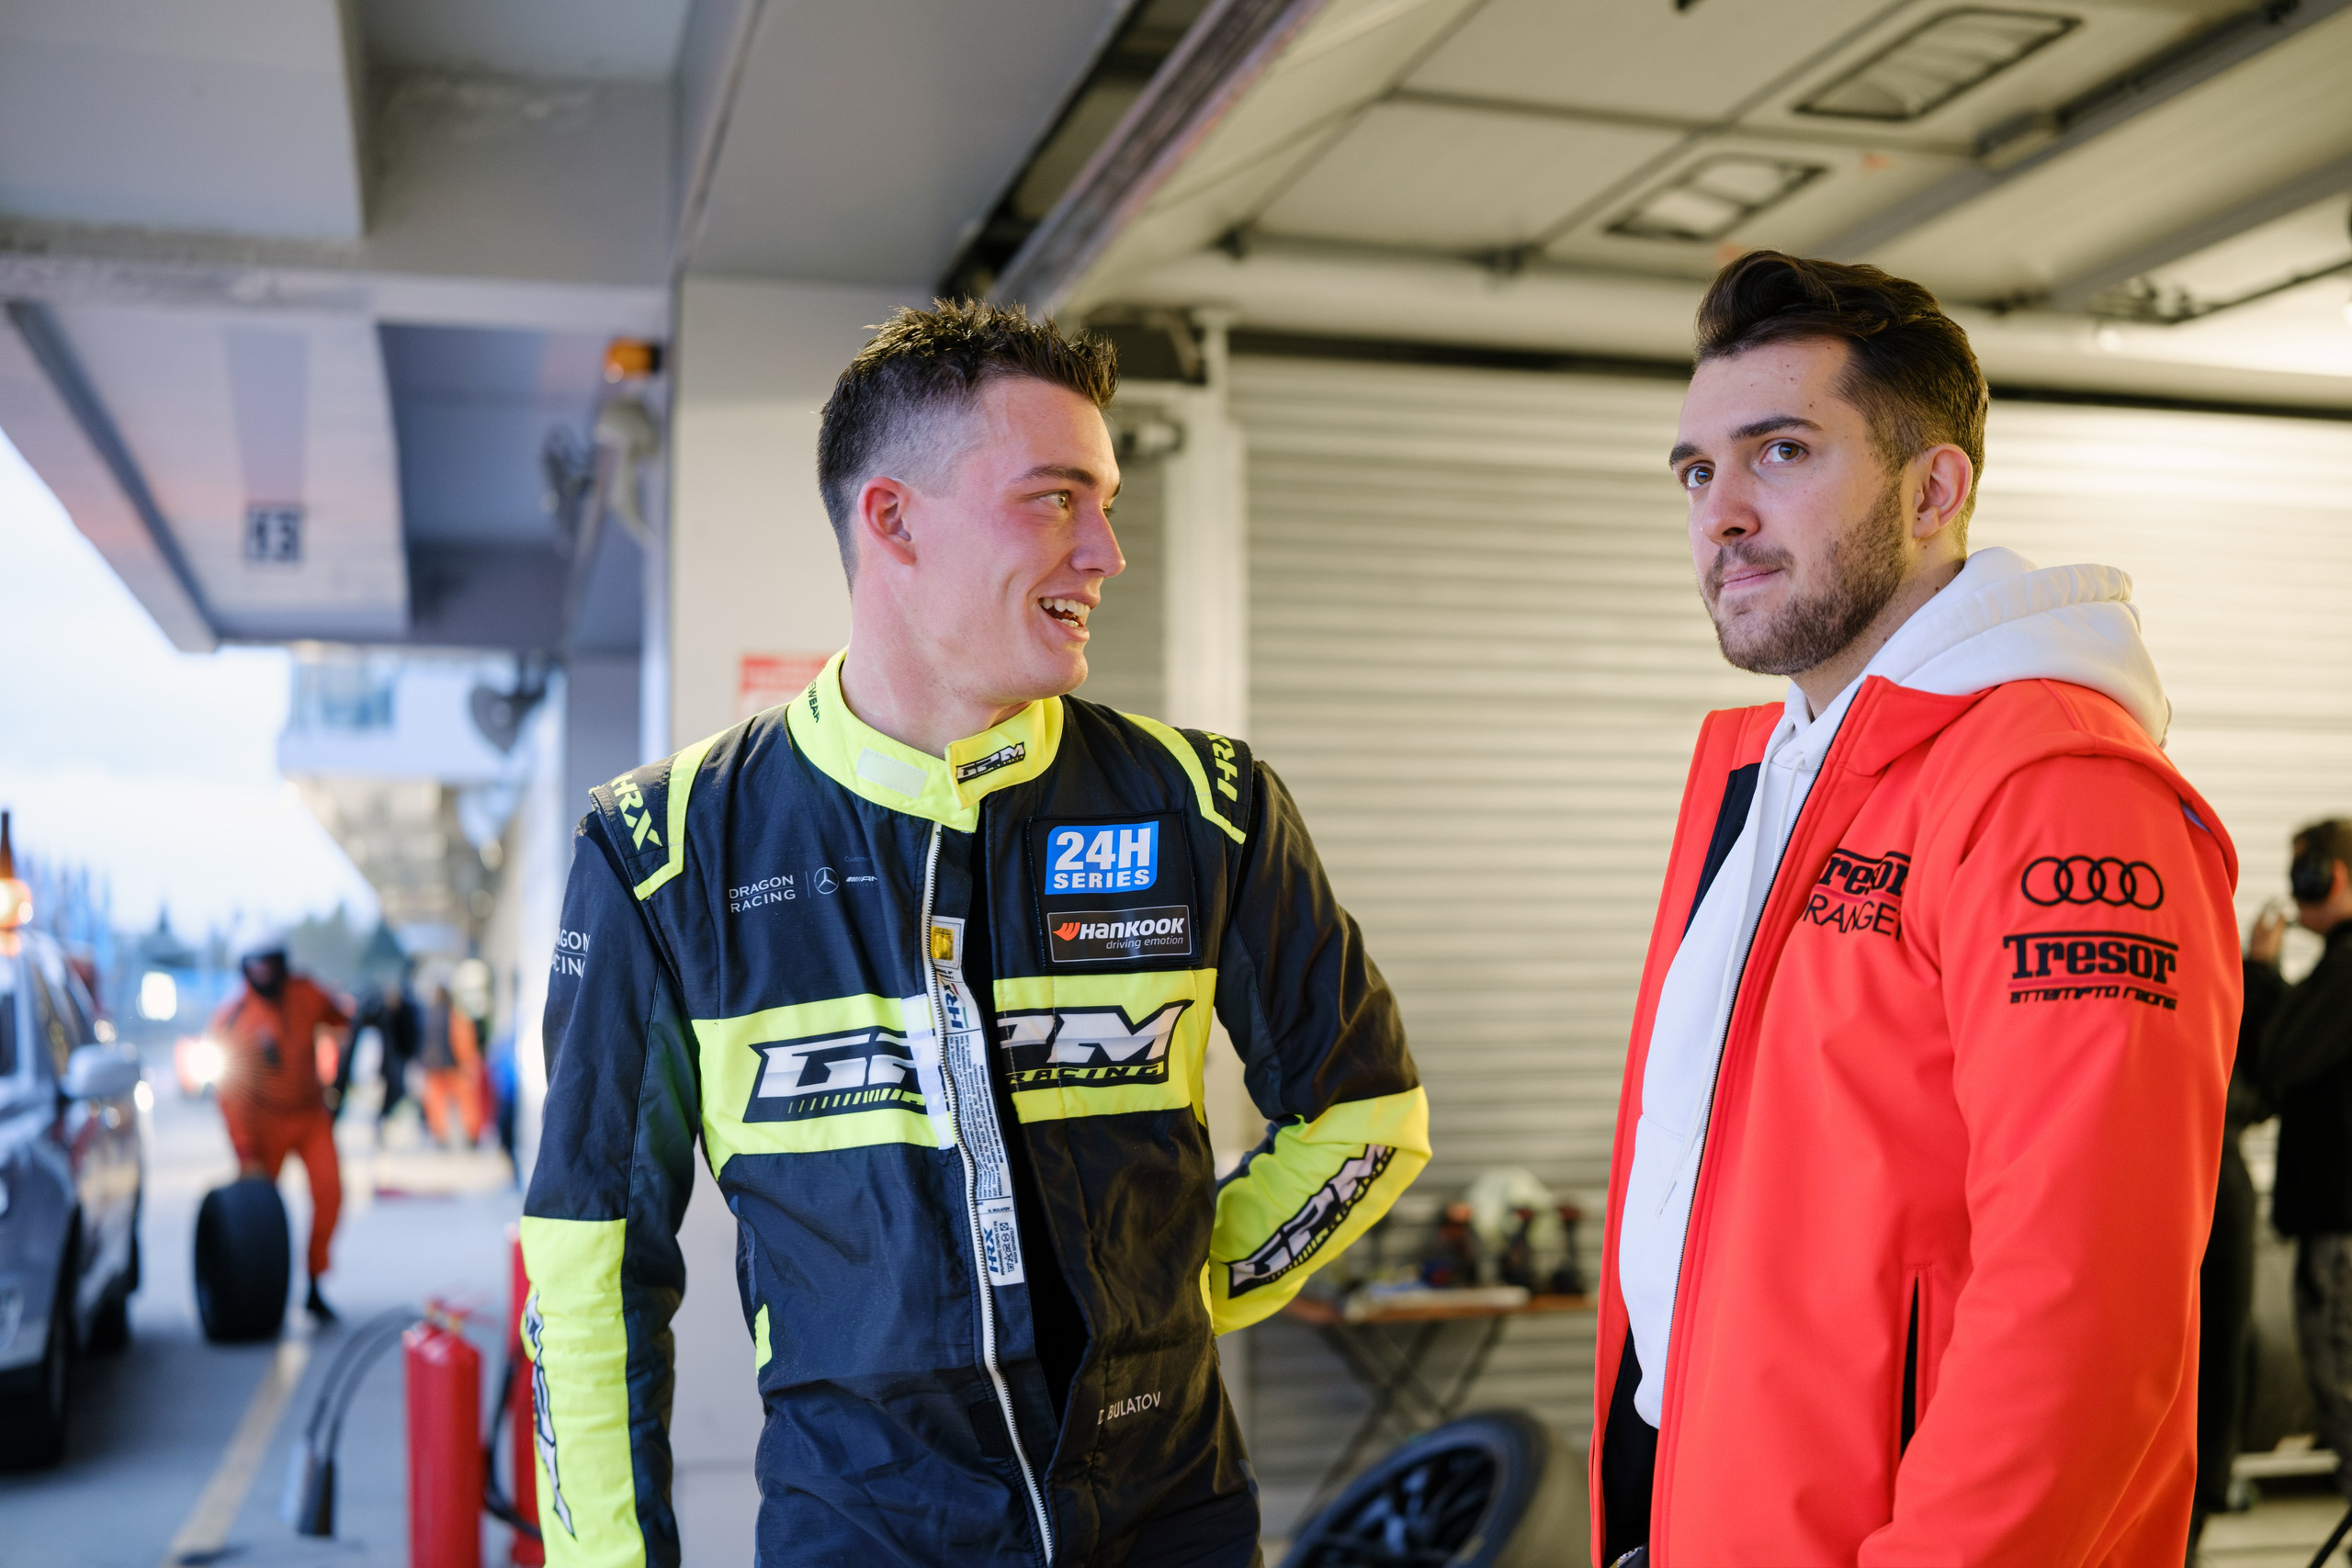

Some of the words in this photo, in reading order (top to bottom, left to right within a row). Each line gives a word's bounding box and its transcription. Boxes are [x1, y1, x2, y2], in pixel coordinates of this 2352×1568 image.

[610, 773, 663, 851] HRX
[1055, 827, 1151, 871] 24H
[729, 874, 795, 899] DRAGON
[1053, 868, 1150, 889] SERIES
[730, 889, 797, 913] RACING
[1105, 938, 1141, 950] driving
[1143, 935, 1183, 946] emotion
[2003, 931, 2178, 984] Tresor
[983, 1226, 999, 1273] HRX
[1106, 1391, 1161, 1421] BULATOV
